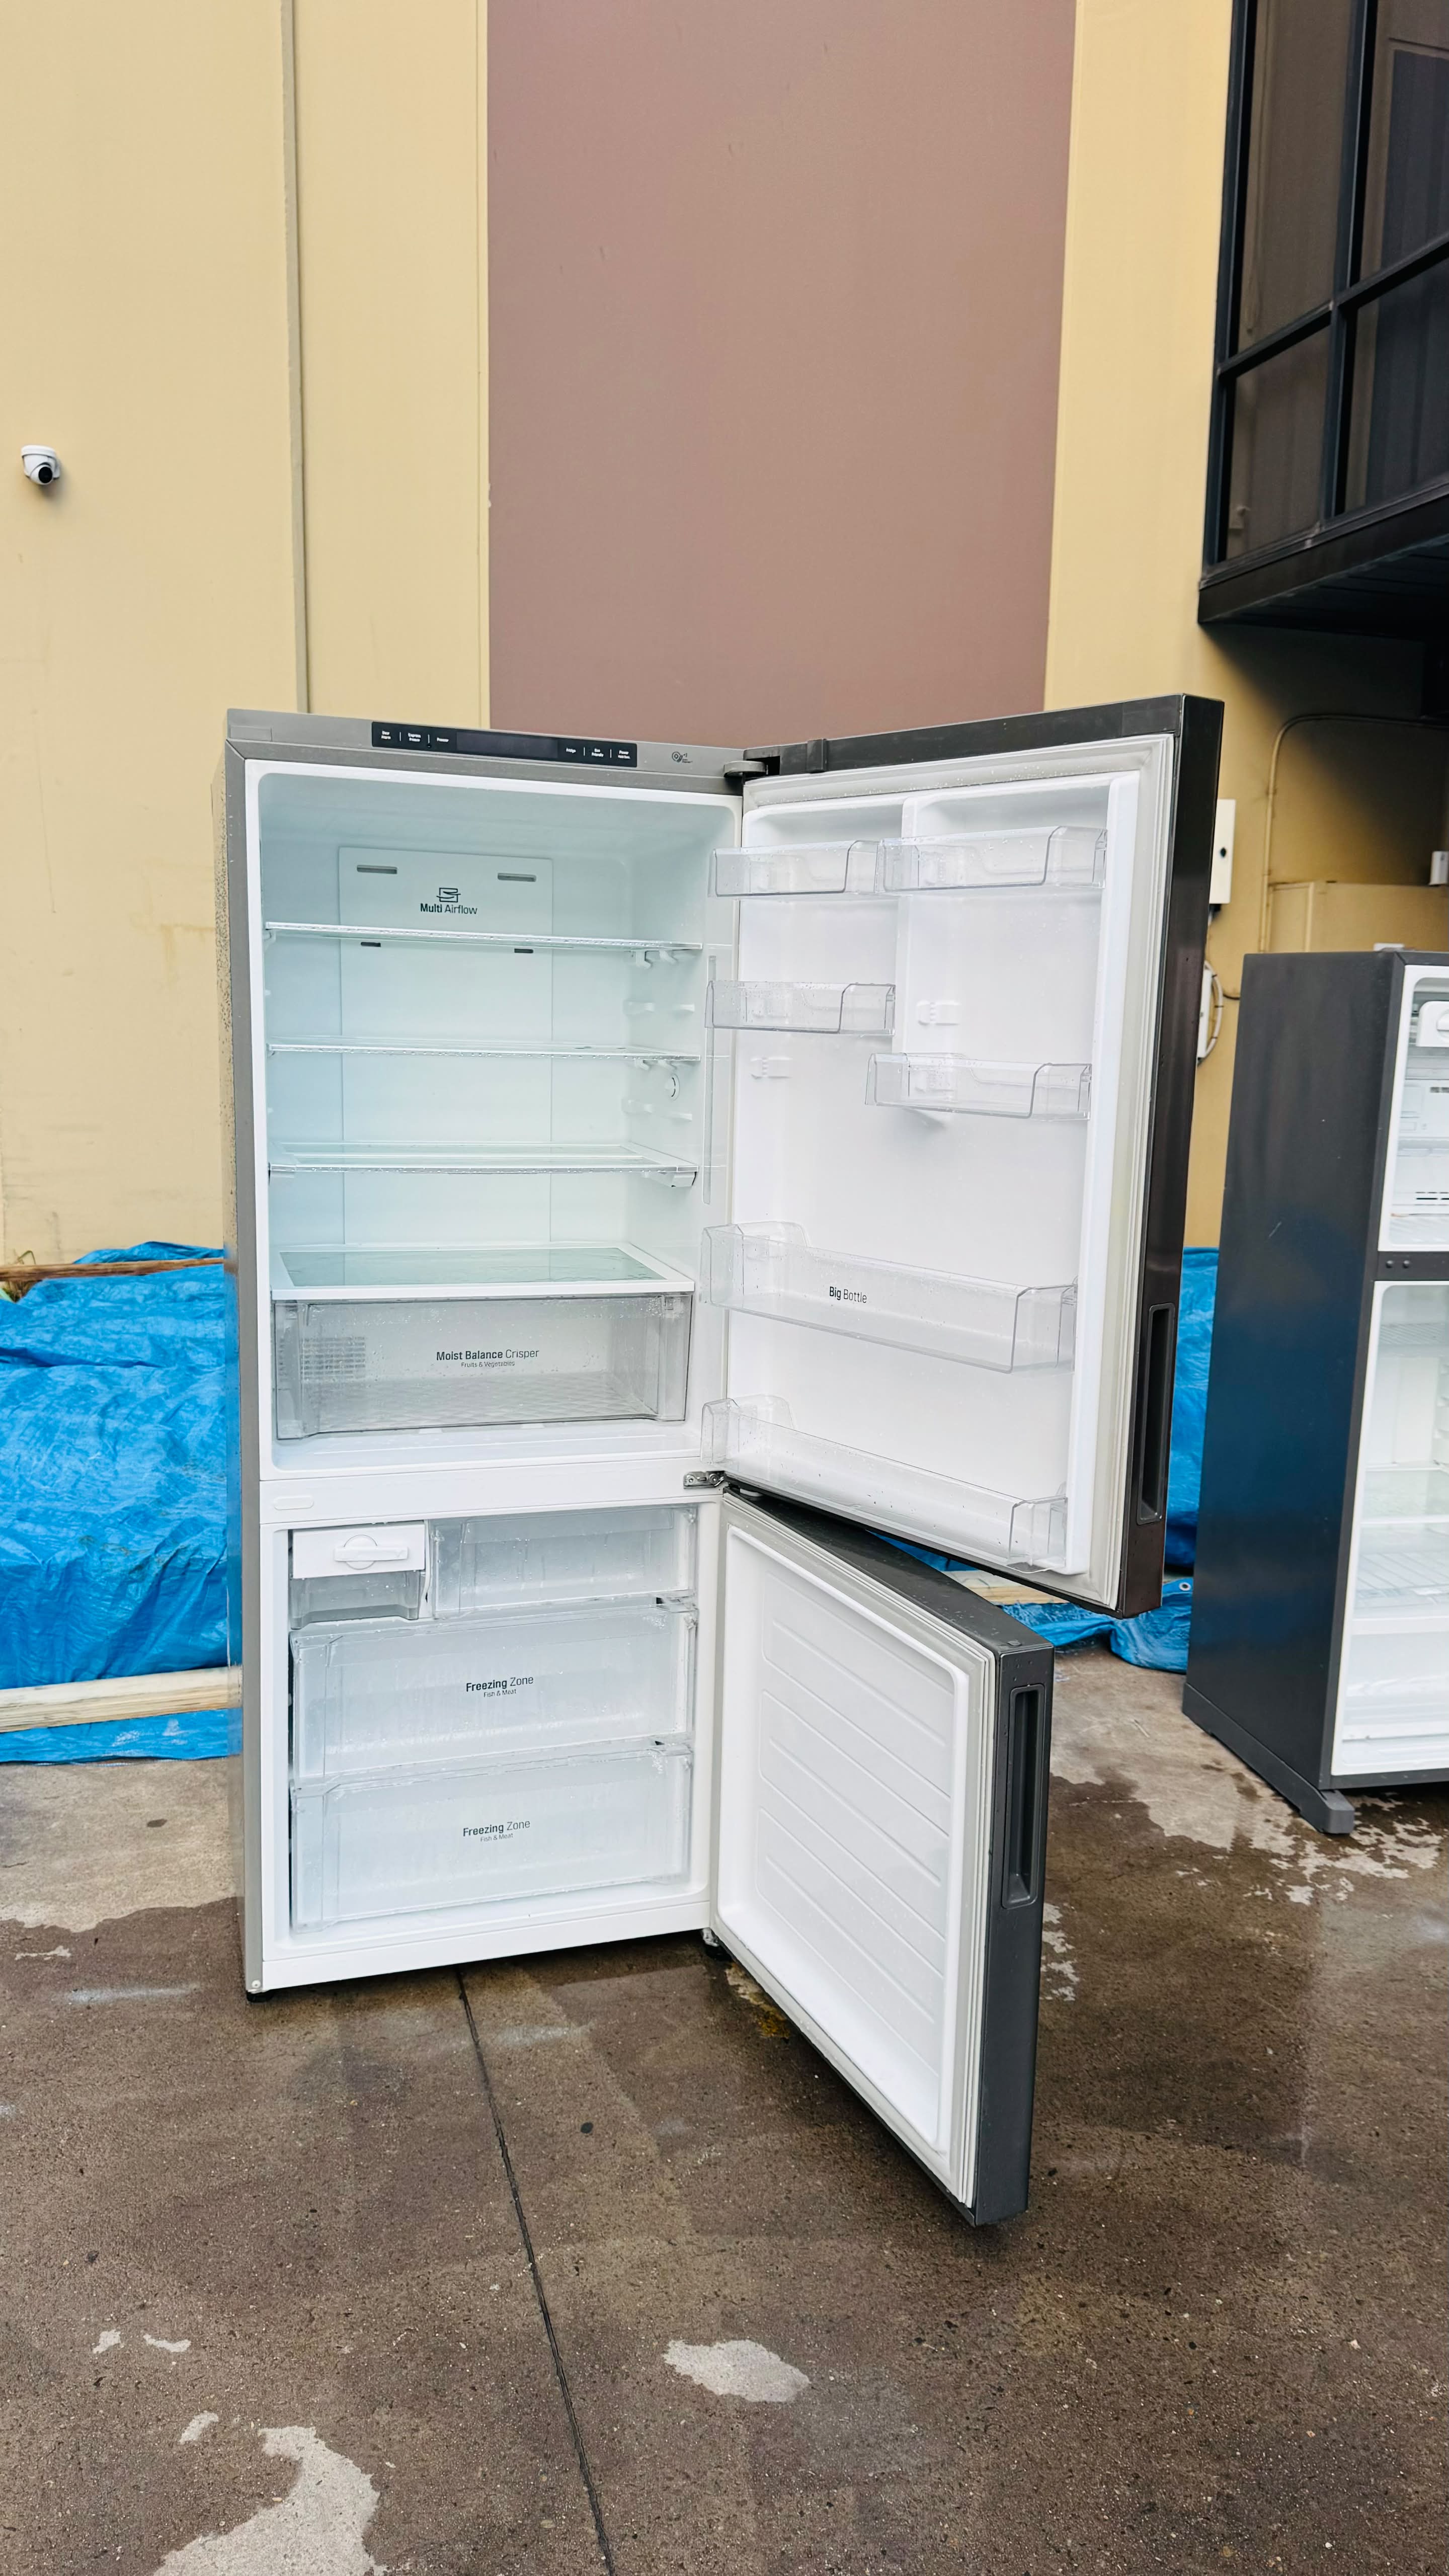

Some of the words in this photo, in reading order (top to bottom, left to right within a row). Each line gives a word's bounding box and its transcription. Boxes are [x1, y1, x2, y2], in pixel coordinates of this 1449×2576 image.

[420, 903, 442, 913] Multi
[444, 905, 477, 914] Airflow
[829, 1286, 841, 1300] Big
[843, 1289, 867, 1303] Bottle
[436, 1351, 463, 1360] Moist
[465, 1350, 503, 1359] Balance
[506, 1349, 540, 1359] Crisper
[466, 1679, 507, 1692] Freezing
[510, 1676, 534, 1686] Zone
[463, 1824, 504, 1836] Freezing
[507, 1821, 531, 1831] Zone
